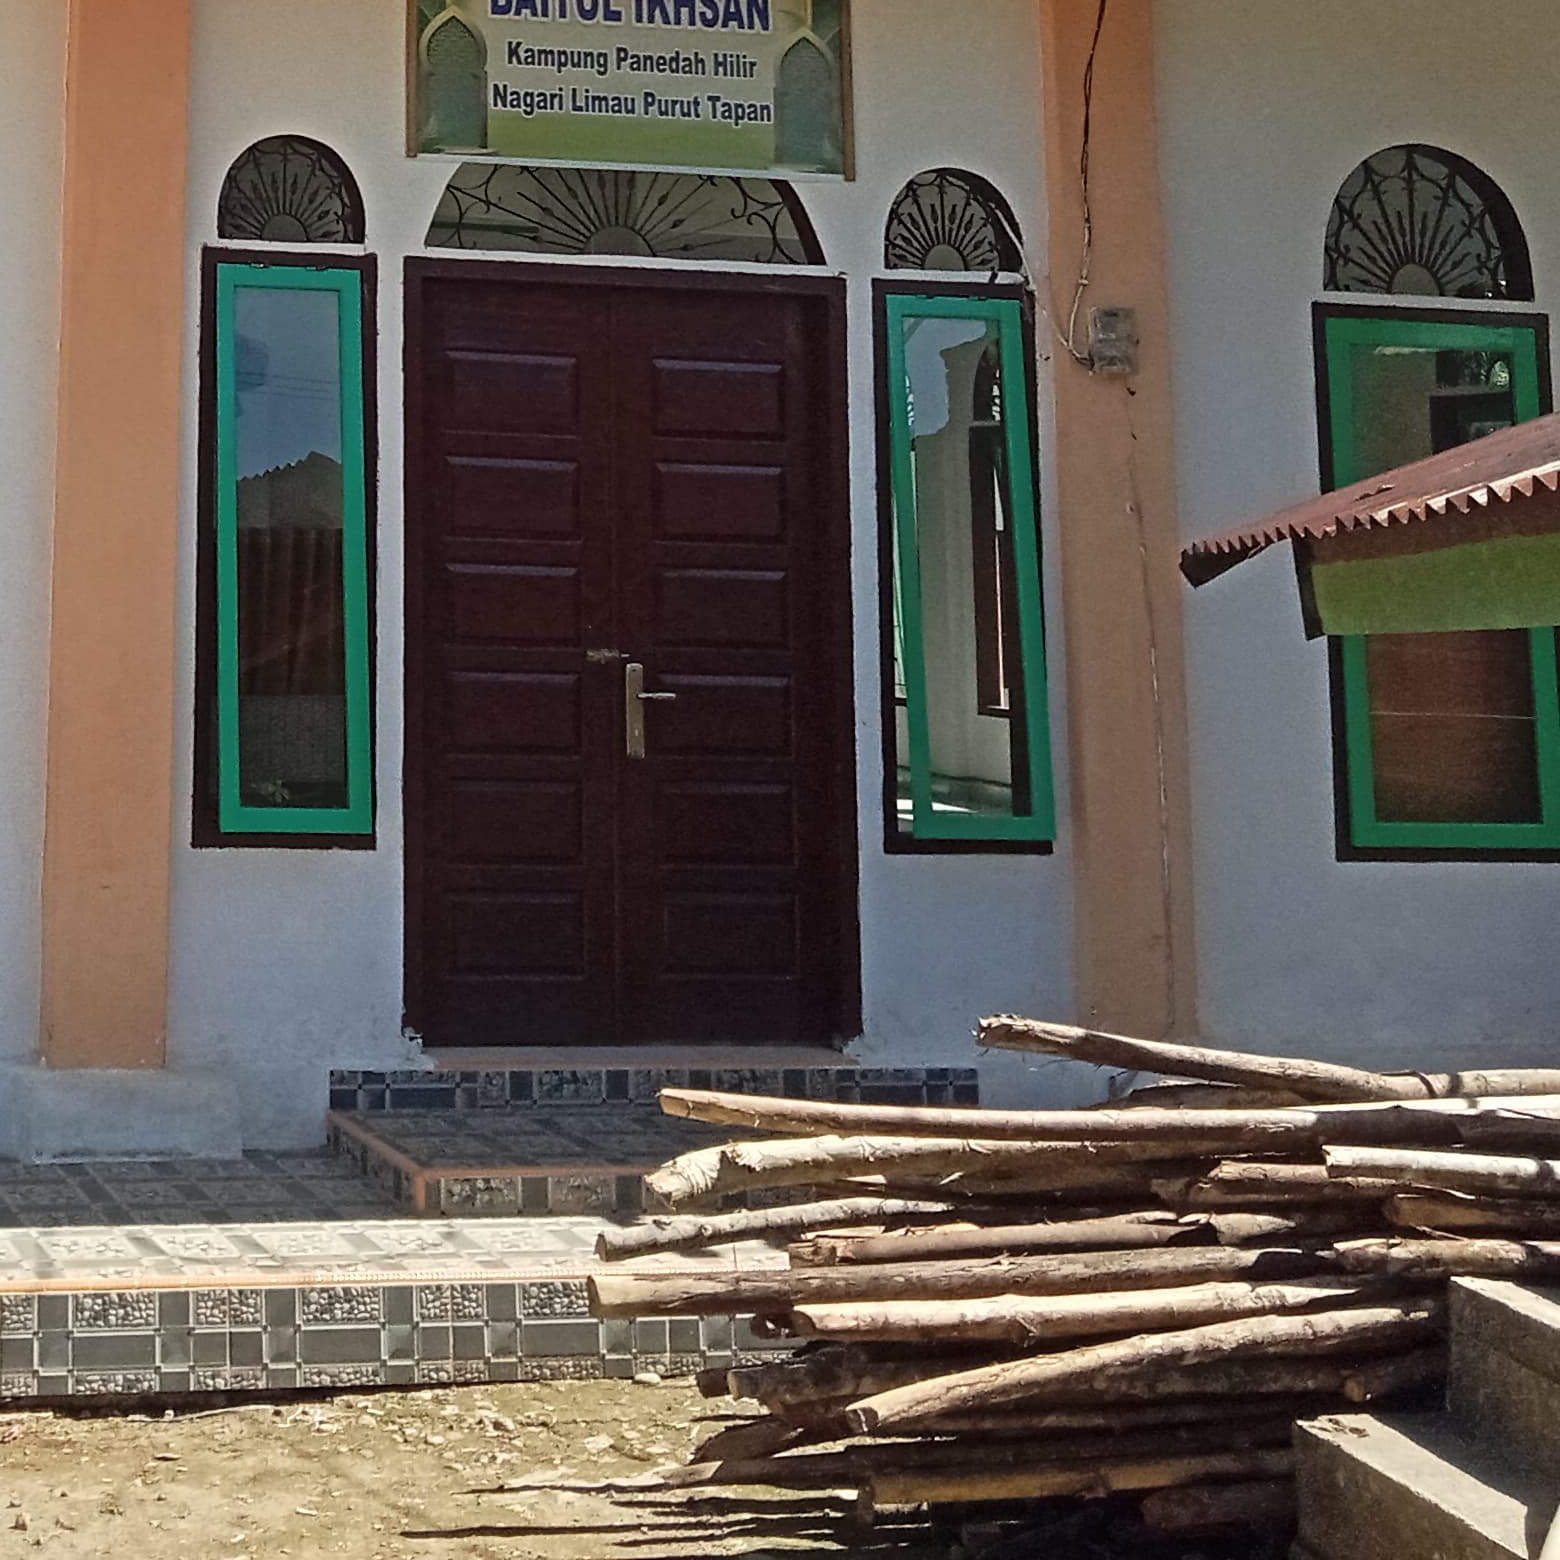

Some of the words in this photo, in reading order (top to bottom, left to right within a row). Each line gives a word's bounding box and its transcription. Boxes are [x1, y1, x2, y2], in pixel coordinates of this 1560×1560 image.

[508, 41, 608, 76] Kampung
[617, 47, 705, 76] Panedah
[713, 54, 757, 78] Hilir
[492, 84, 564, 117] Nagari
[571, 88, 635, 115] Limau
[644, 92, 700, 118] Purut
[707, 96, 772, 126] Tapan
